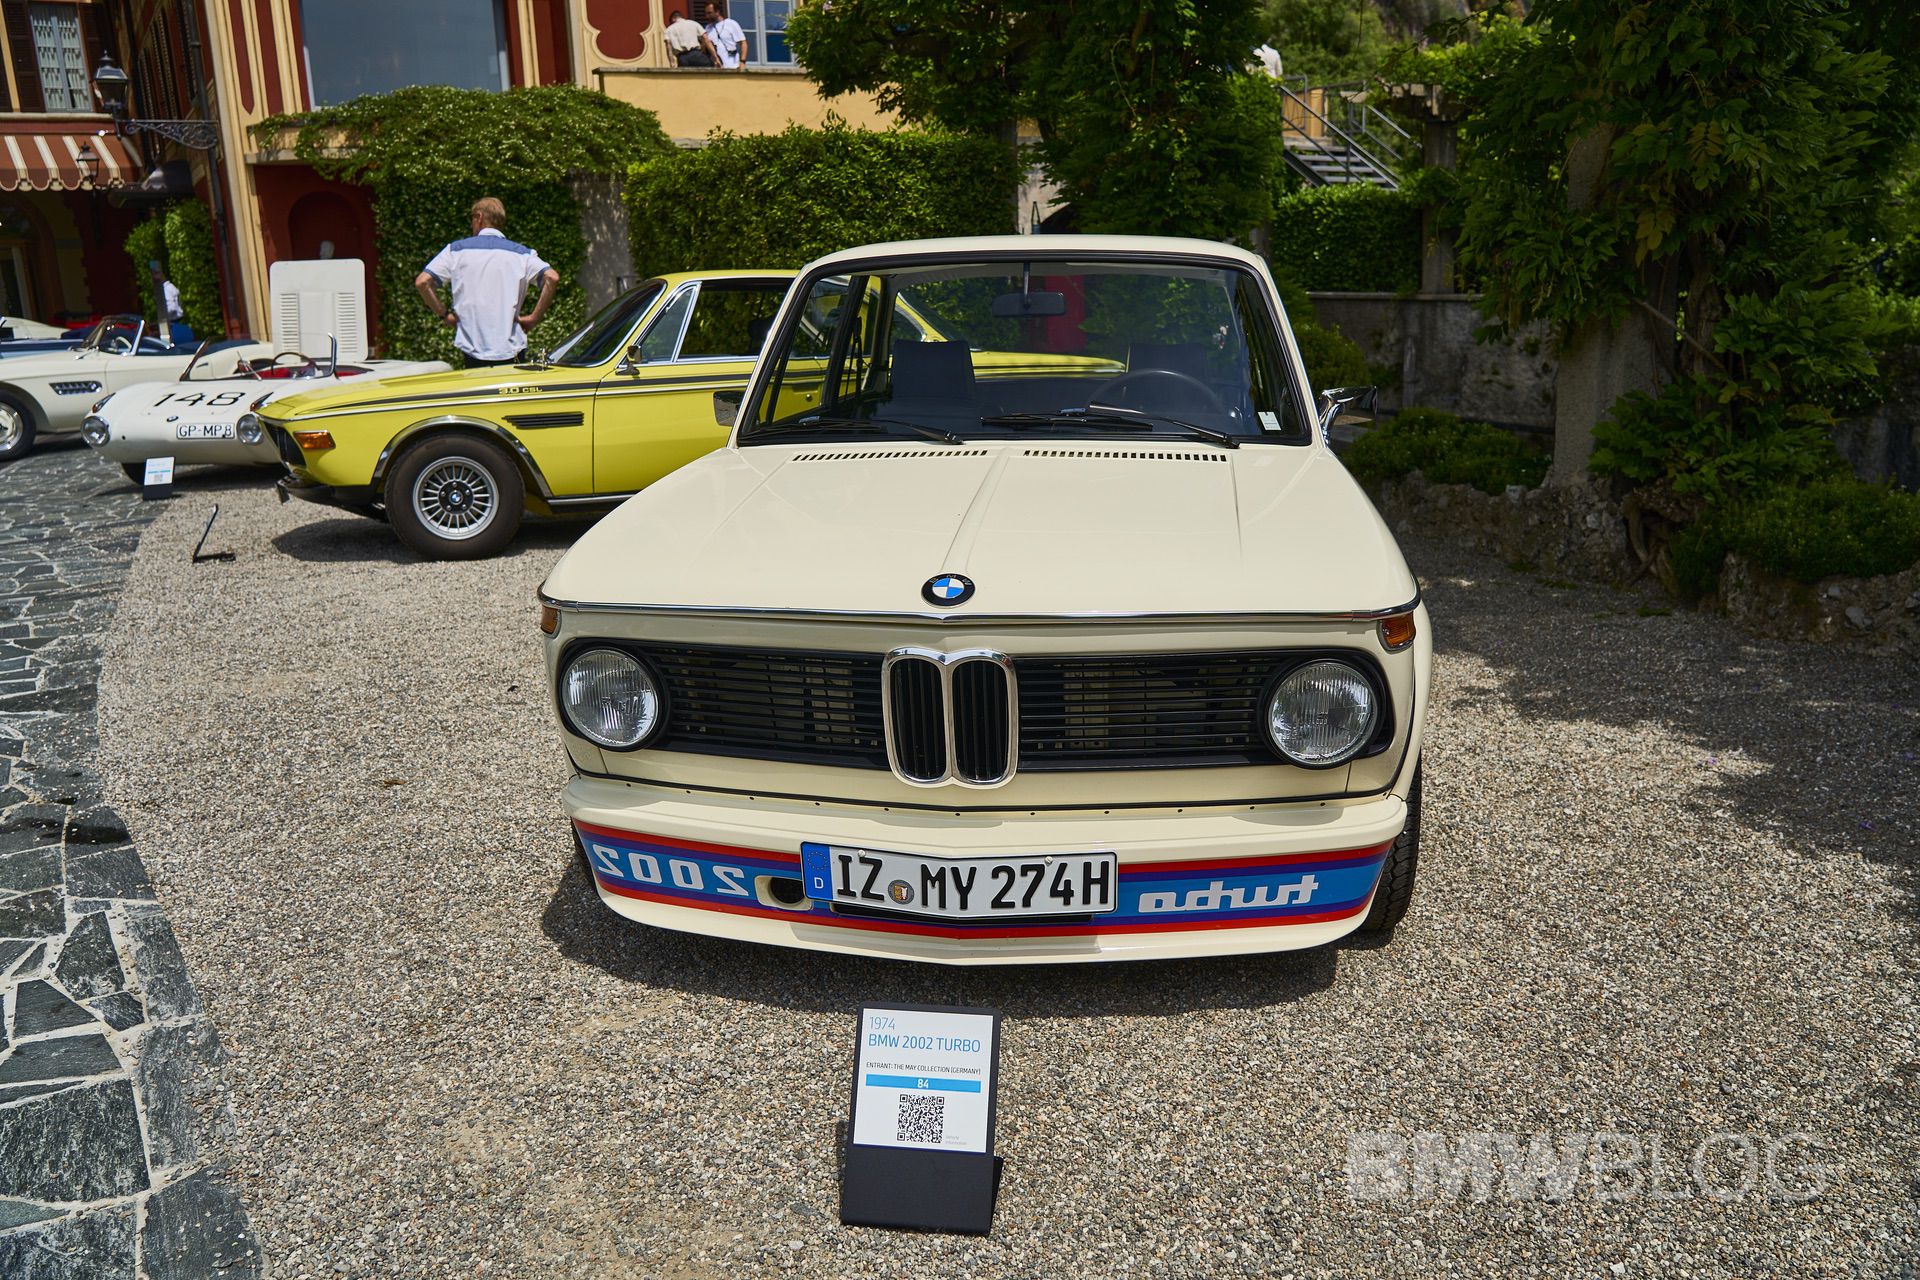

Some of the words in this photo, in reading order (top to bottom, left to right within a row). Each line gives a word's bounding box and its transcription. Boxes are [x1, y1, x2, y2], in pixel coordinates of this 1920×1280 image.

[154, 391, 246, 408] 148
[814, 876, 824, 889] D
[837, 854, 885, 901] IZ
[920, 863, 977, 910] MY
[990, 860, 1110, 910] 274H
[869, 1016, 896, 1030] 1974
[868, 1033, 900, 1048] BMW
[902, 1035, 933, 1050] 2002
[936, 1037, 981, 1053] TURBO
[866, 1061, 893, 1070] ENTRANT:
[894, 1063, 905, 1071] THE
[905, 1064, 916, 1072] MAY
[917, 1065, 950, 1074] COLLECTION
[917, 1078, 929, 1089] 84
